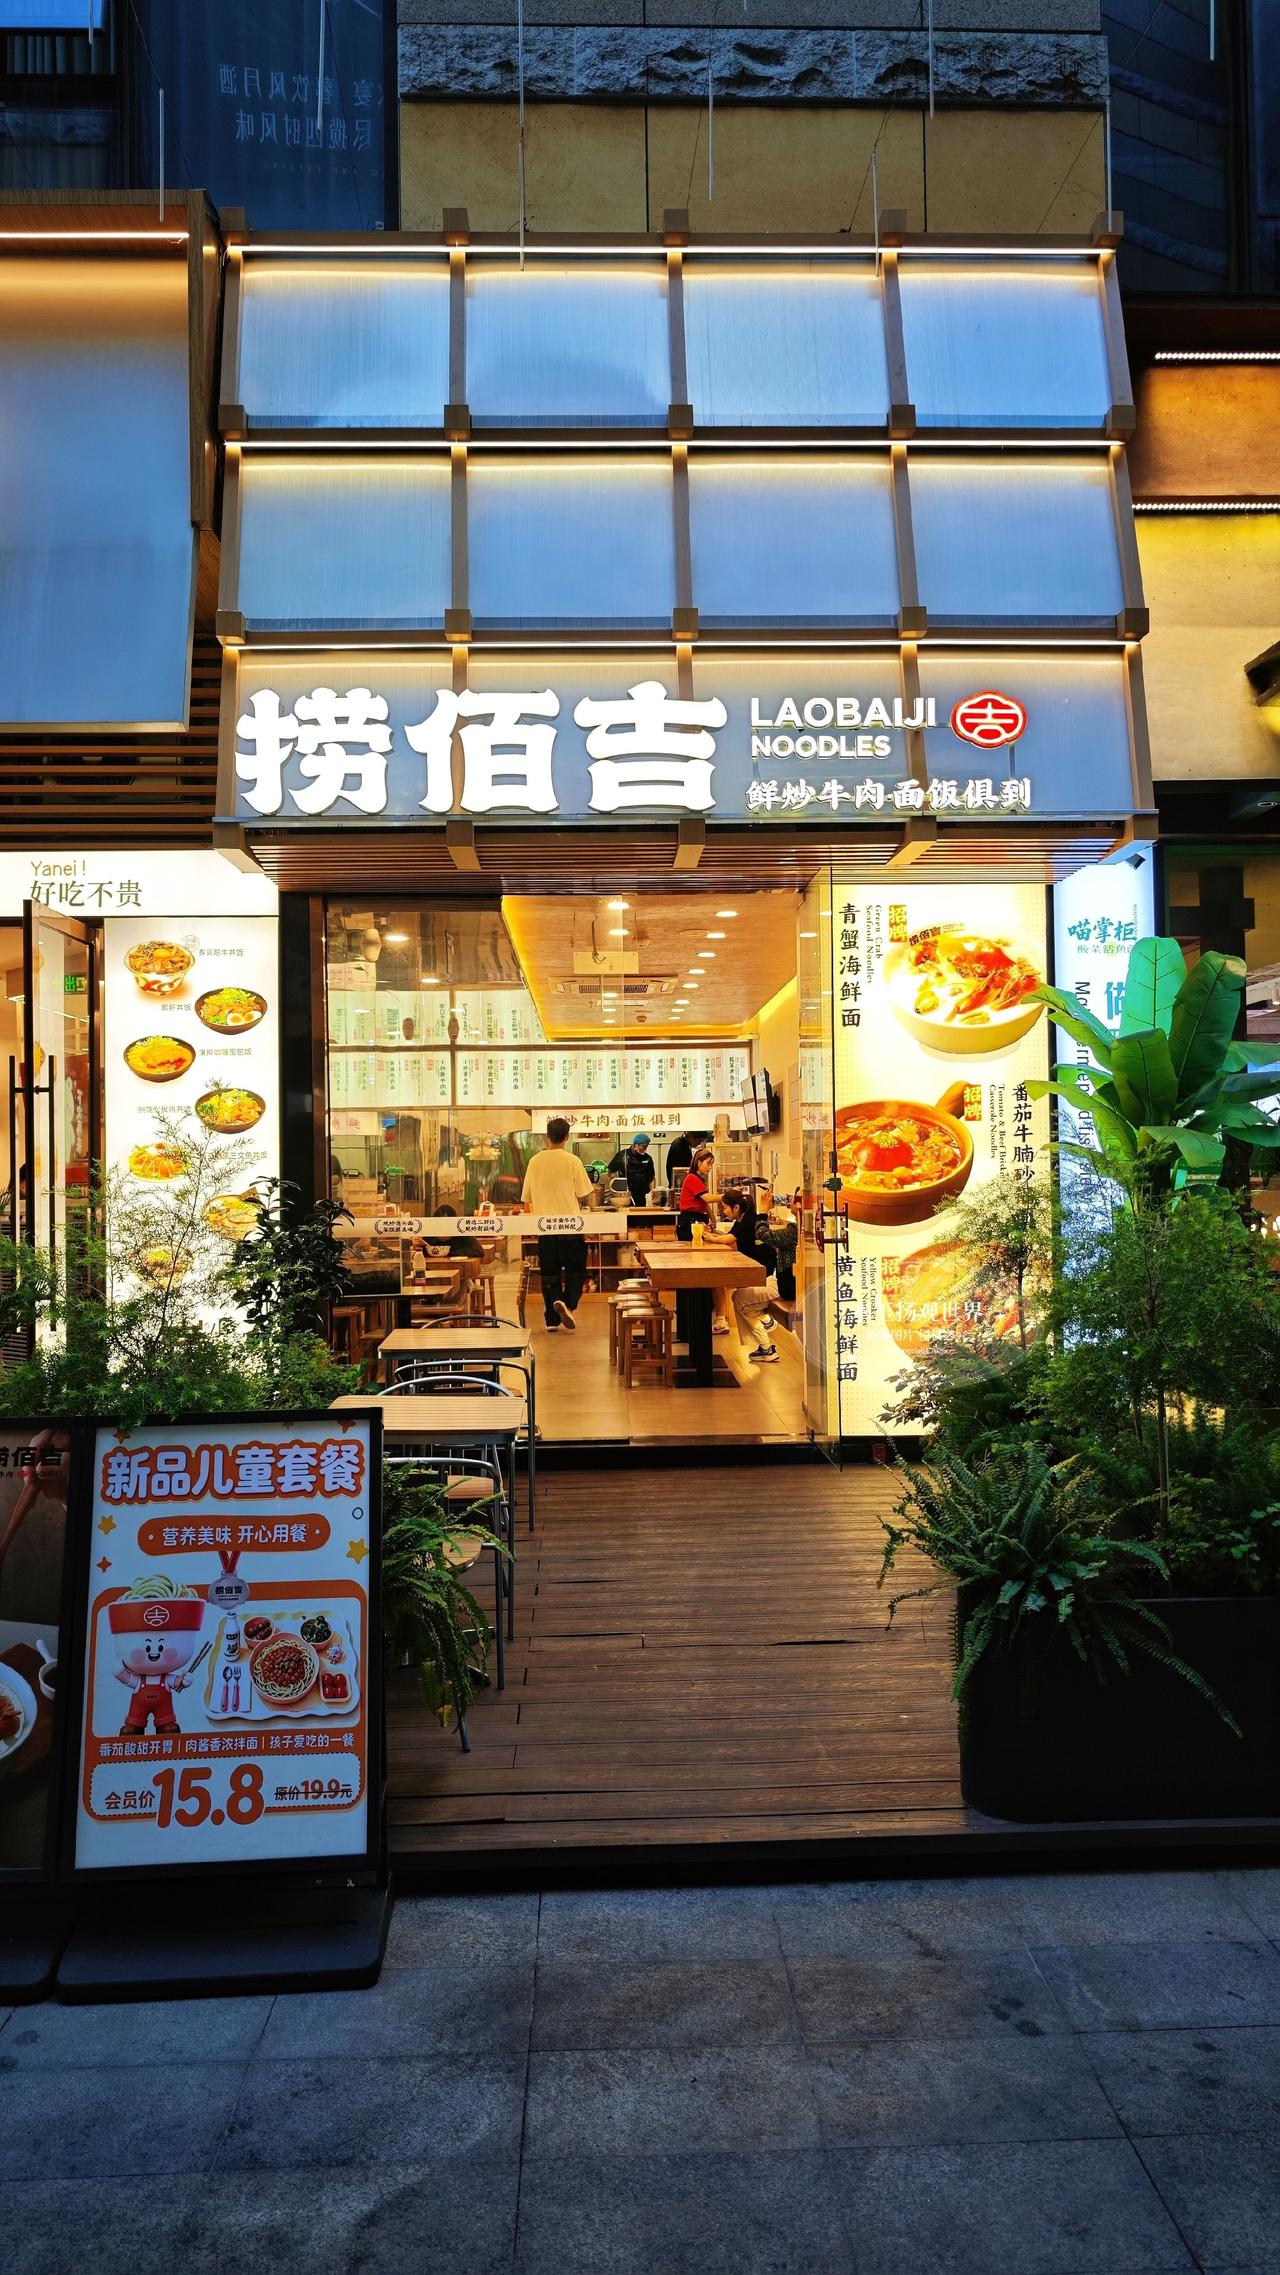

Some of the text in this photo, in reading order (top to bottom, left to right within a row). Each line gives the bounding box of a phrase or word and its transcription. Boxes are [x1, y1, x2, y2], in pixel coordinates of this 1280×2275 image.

[751, 697, 936, 728] LAOBAIJI
[235, 681, 728, 814] 捞佰吉
[751, 735, 891, 758] NOODLES
[30, 879, 143, 908] 好吃不贵
[889, 904, 907, 942] 招牌
[1067, 917, 1138, 943] 喵掌柜
[866, 904, 875, 984] Seafood Noodles
[875, 937, 883, 959] Crab
[839, 903, 862, 1028] 青蟹海鲜面
[963, 1084, 982, 1121] 招牌
[998, 1083, 1006, 1118] Tomato
[989, 1084, 998, 1159] Casserole Noodles
[999, 1130, 1007, 1151] Beef
[860, 1257, 868, 1290] Seafood
[869, 1257, 878, 1321] Yellow Croaker
[832, 1255, 858, 1381] 黄鱼海鲜面
[105, 1443, 361, 1500] 新品儿童套餐
[162, 1523, 309, 1546] 营养美味 开心用餐
[99, 1732, 355, 1757] 番茄酸甜开胃 肉酱香浓拌面 孩子爱吃的一餐
[104, 1790, 155, 1810] 会员价
[152, 1763, 266, 1829] 15.8
